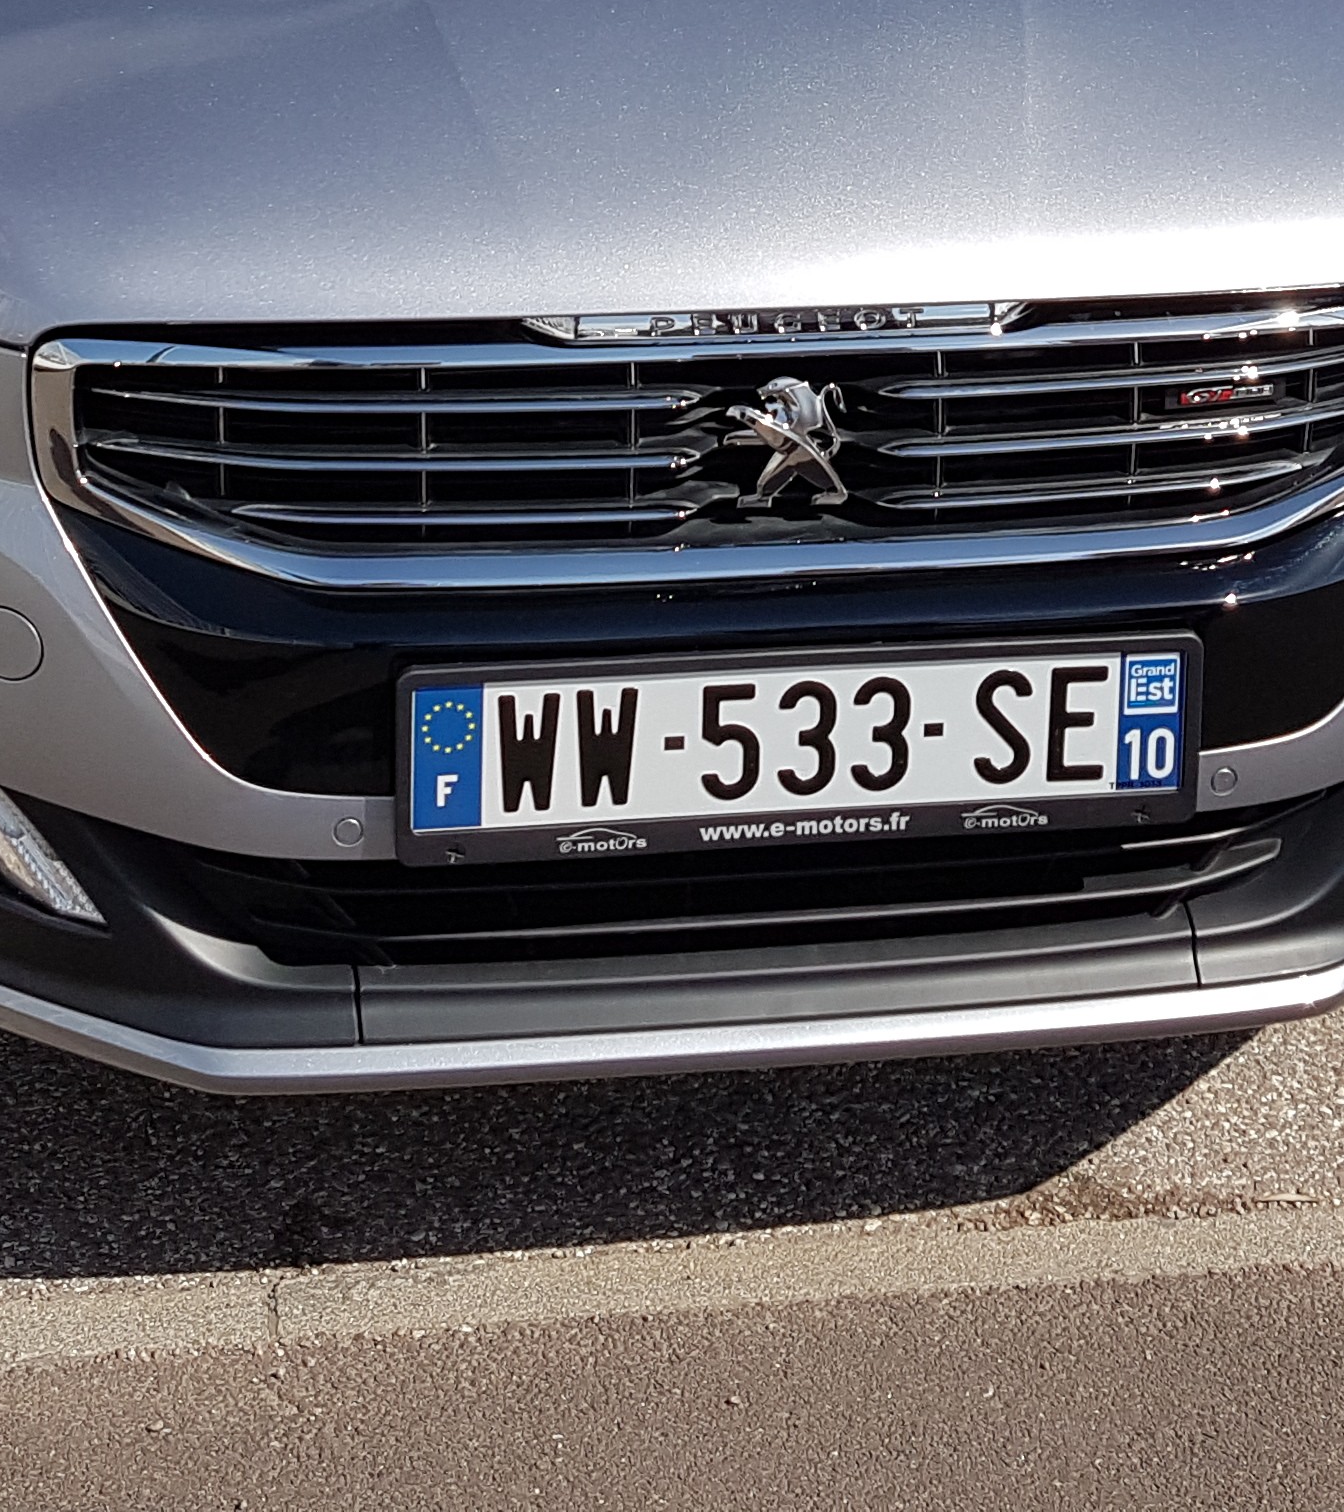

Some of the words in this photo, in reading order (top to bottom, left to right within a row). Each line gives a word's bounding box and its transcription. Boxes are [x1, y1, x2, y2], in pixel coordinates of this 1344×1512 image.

[649, 307, 925, 336] PEUGEOT
[1131, 662, 1175, 677] Grand
[1129, 677, 1174, 702] Est
[1124, 727, 1175, 781] 10
[436, 774, 458, 807] F
[700, 811, 910, 842] www.e-motors.fr
